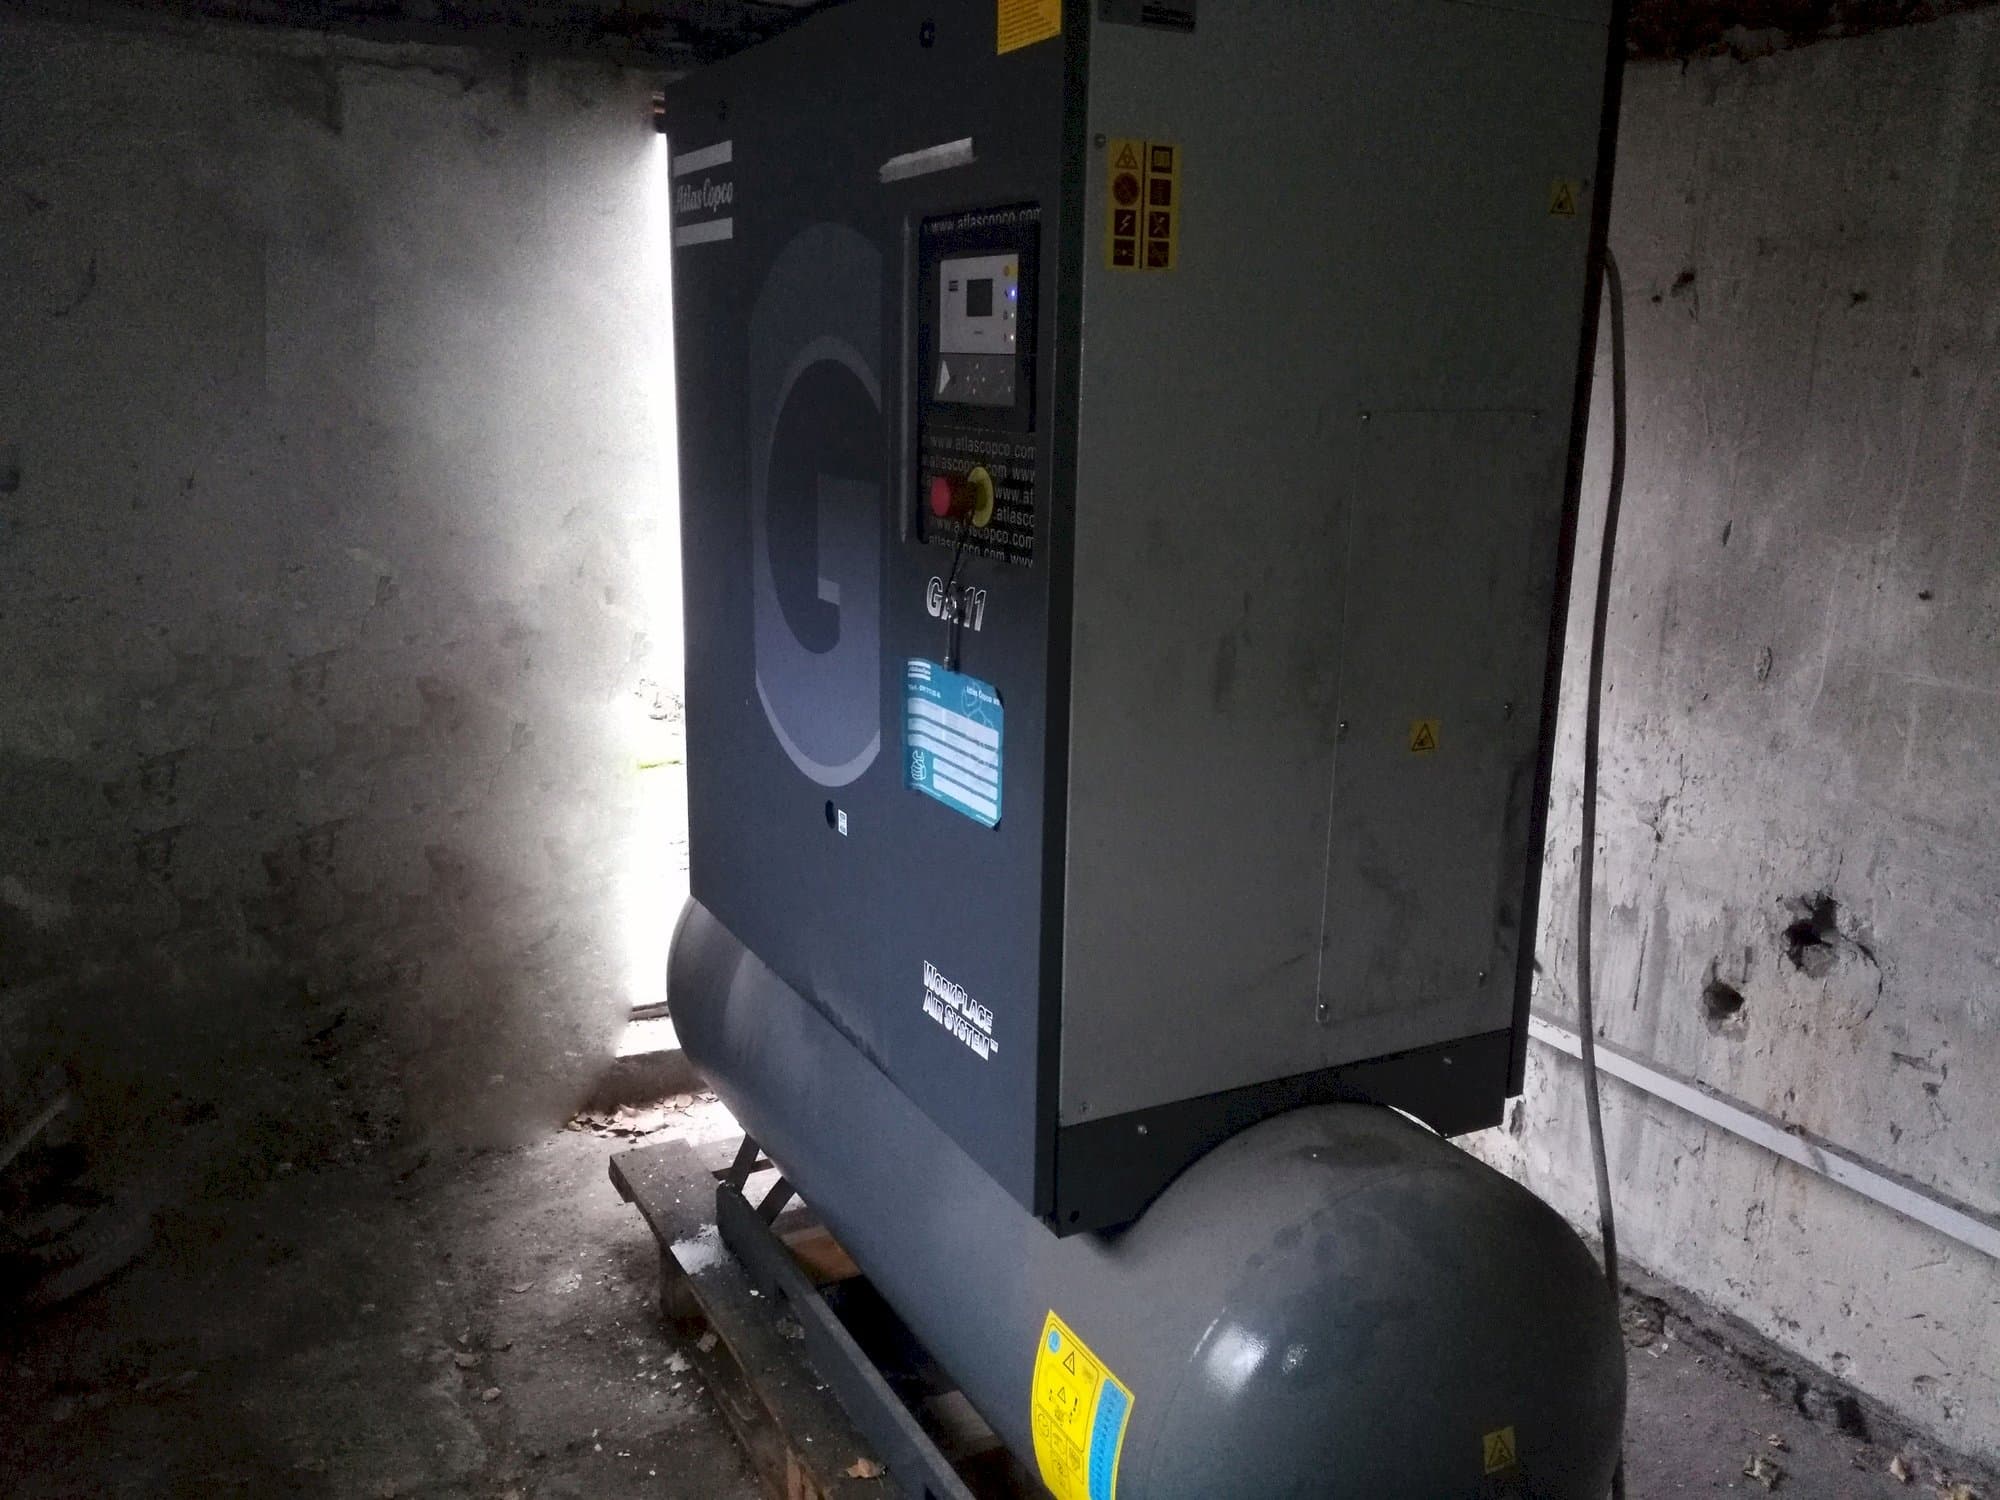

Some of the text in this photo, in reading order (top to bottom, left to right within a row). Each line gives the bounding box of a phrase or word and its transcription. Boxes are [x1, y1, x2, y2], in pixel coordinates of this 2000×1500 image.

[676, 178, 734, 213] Atlas Copco
[963, 587, 987, 632] 11
[922, 988, 943, 1025] AIR
